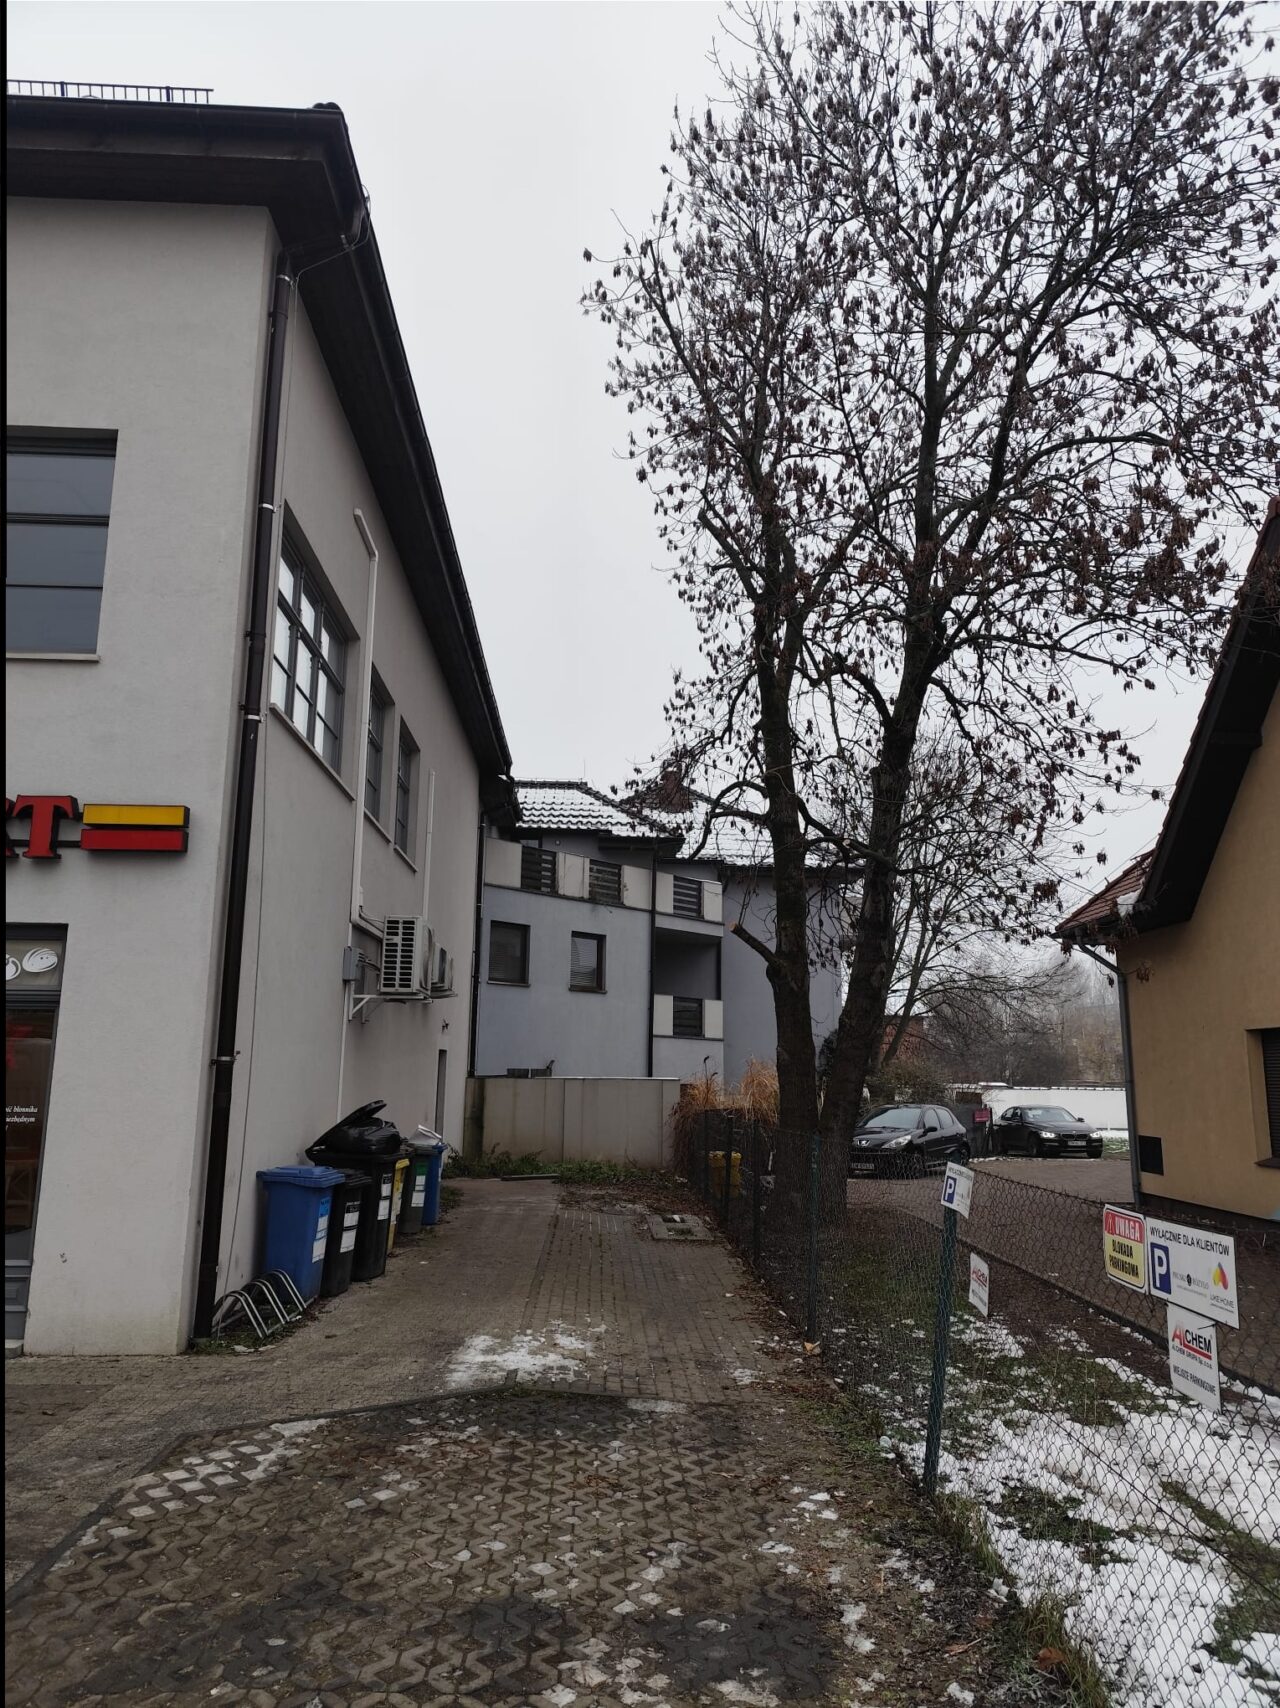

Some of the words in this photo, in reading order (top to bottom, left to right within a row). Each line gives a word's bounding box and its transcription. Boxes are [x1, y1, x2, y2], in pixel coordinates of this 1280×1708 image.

[6, 795, 79, 859] T
[1115, 1216, 1140, 1241] UWAGA
[1183, 1235, 1195, 1247] DLA
[1196, 1239, 1230, 1256] KLIENTÓW
[1154, 1247, 1167, 1287] P
